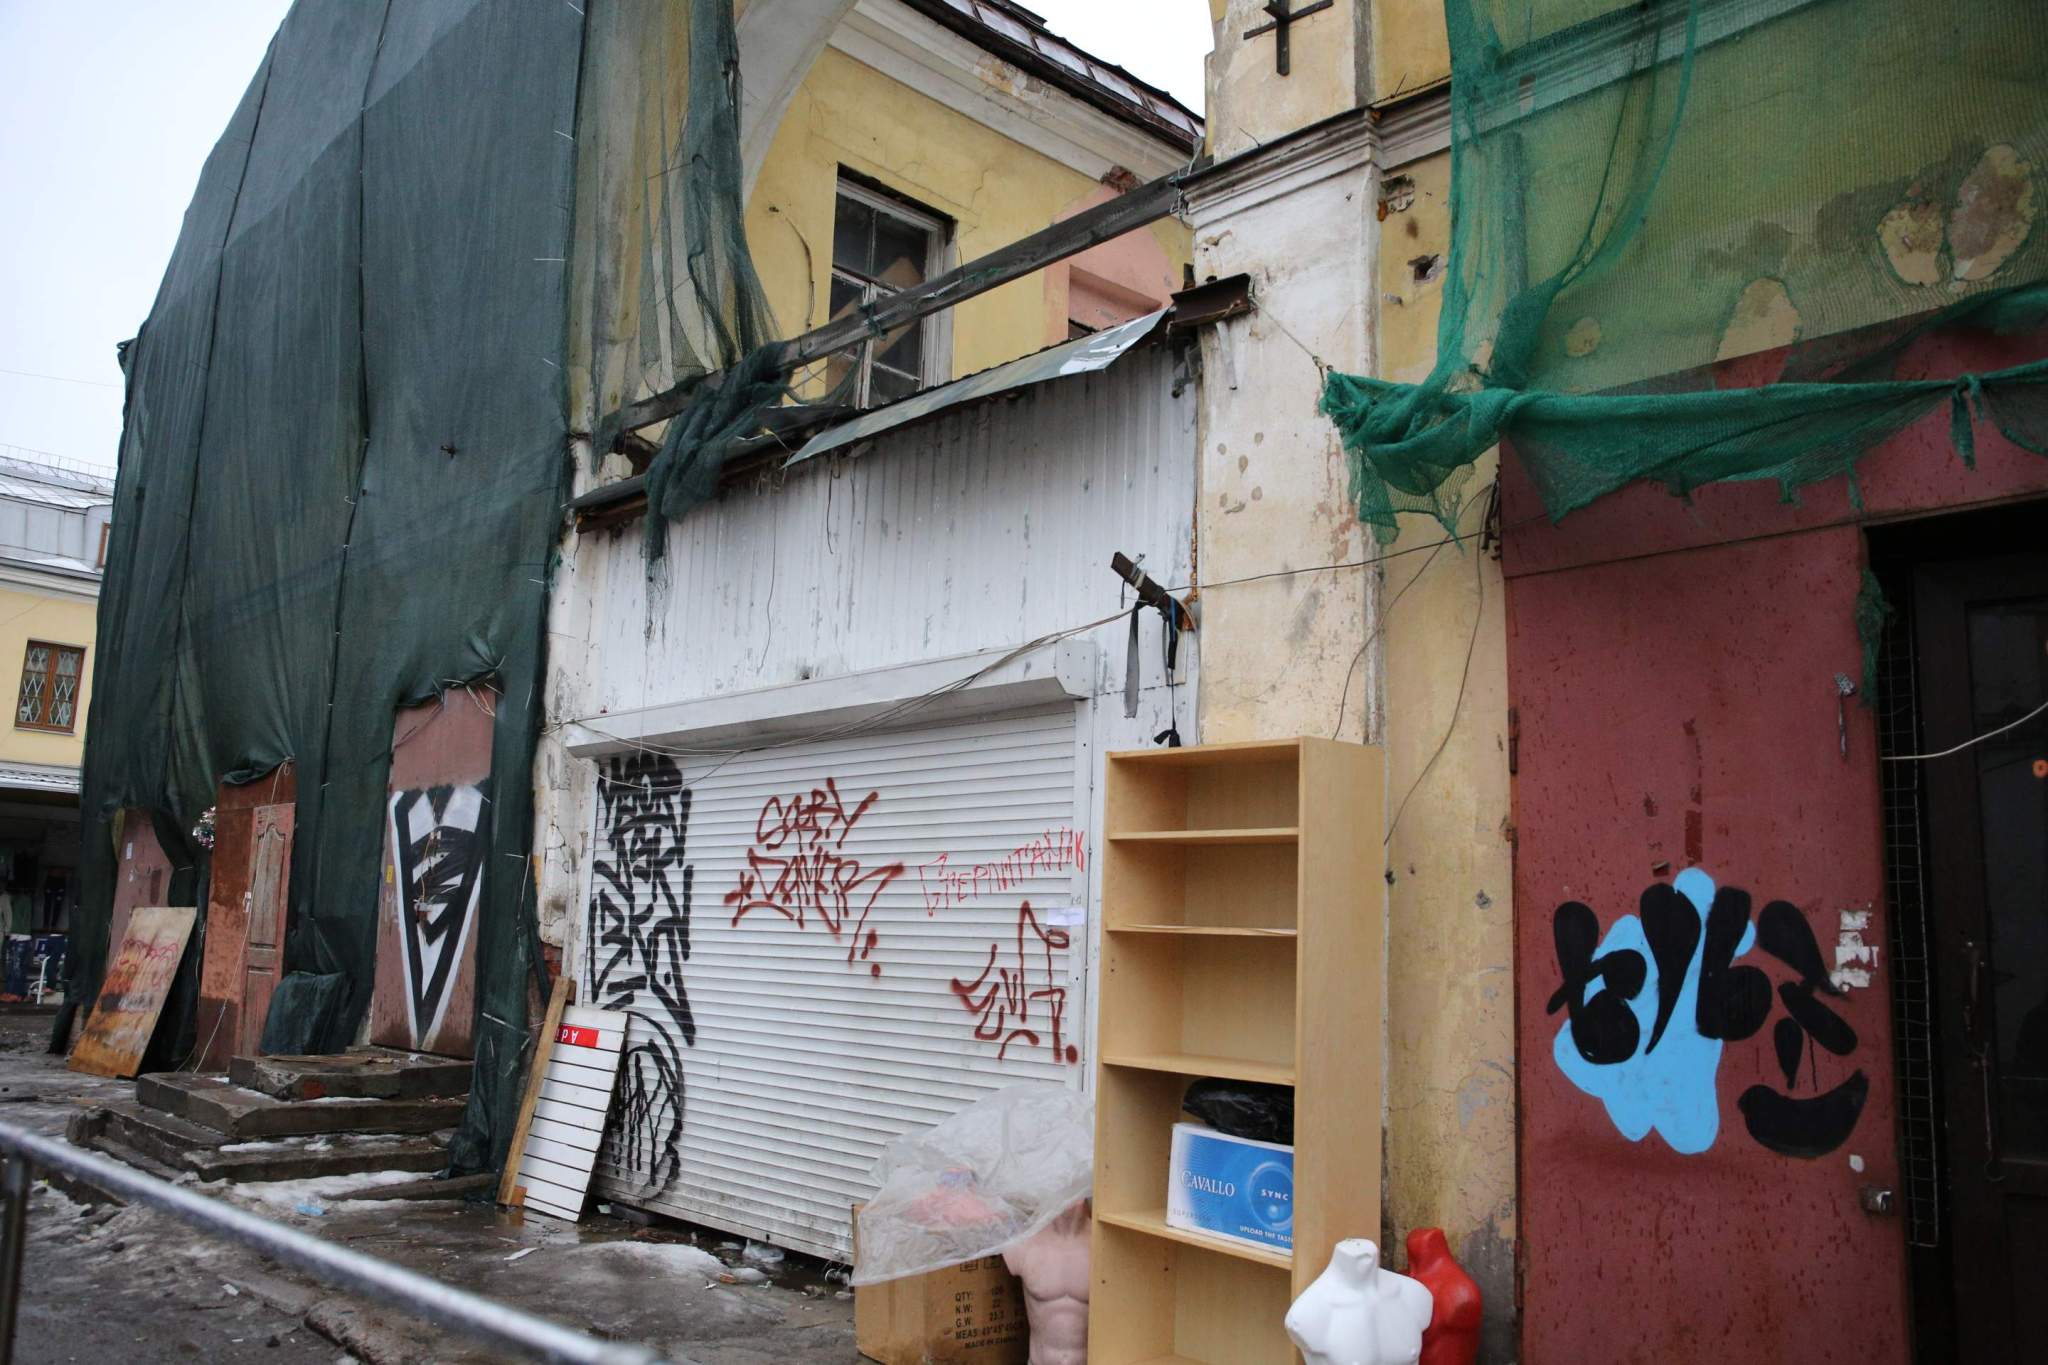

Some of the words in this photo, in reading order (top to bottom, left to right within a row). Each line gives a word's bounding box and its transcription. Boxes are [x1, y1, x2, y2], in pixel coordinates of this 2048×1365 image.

[1180, 1168, 1236, 1198] CAVALLO
[1261, 1188, 1289, 1201] SYNC
[1239, 1225, 1264, 1237] UPLOAD
[1264, 1231, 1276, 1239] THE
